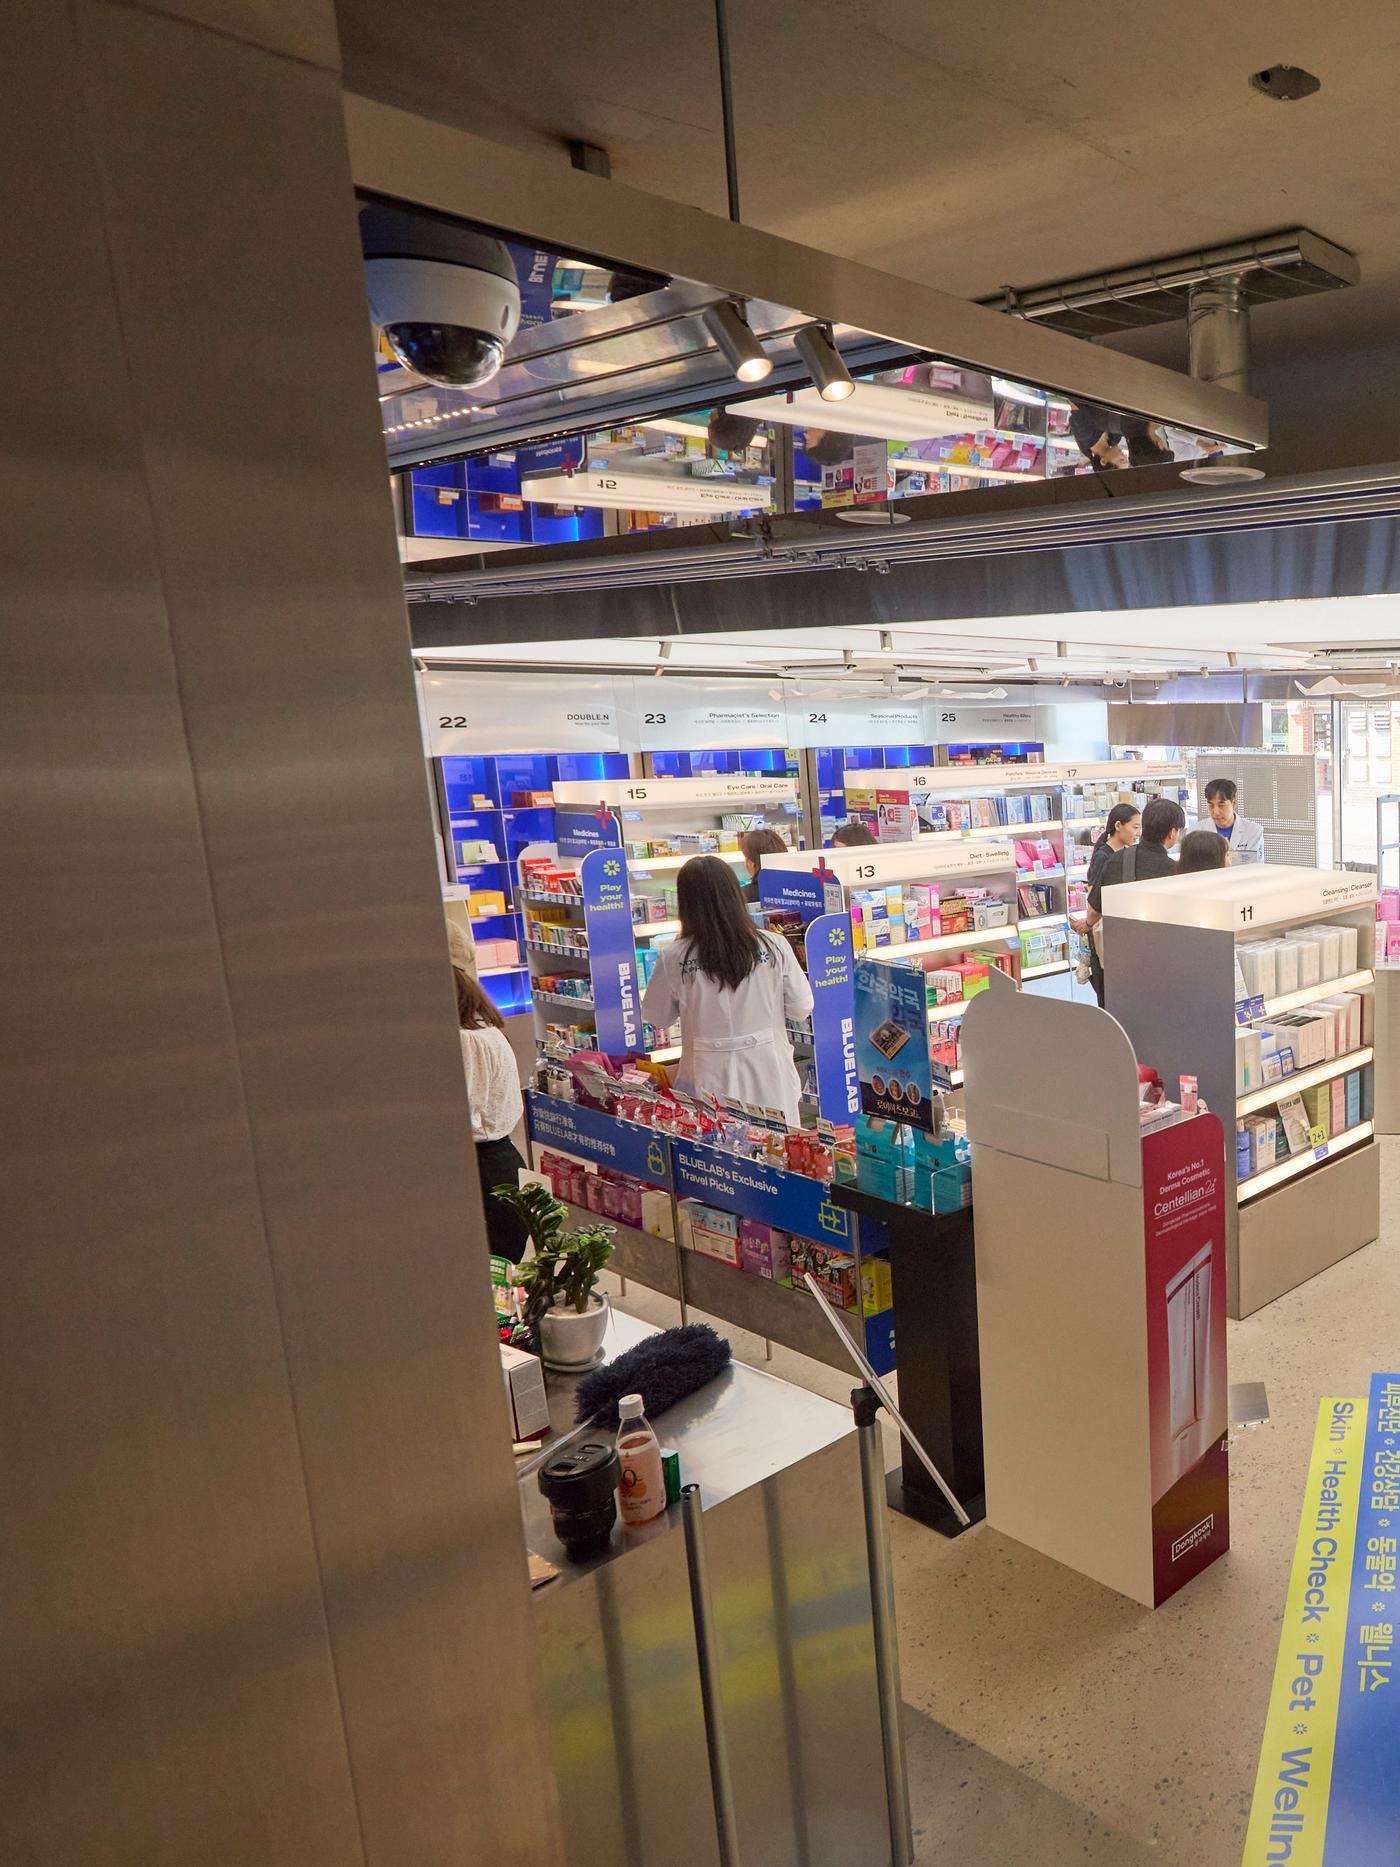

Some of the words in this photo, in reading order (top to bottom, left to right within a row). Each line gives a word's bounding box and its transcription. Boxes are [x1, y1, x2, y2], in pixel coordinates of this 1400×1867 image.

[439, 716, 468, 729] 22
[644, 713, 667, 725] 23
[809, 713, 828, 723] 24
[941, 713, 957, 722] 25
[1066, 769, 1077, 777] 17
[913, 776, 927, 786] 16
[627, 788, 647, 800] 15
[985, 850, 1010, 860] Swelling
[856, 865, 875, 879] 13
[600, 884, 621, 893] Play
[782, 887, 817, 899] Medicines
[1323, 886, 1349, 898] Cleansing
[1351, 882, 1373, 892] Cleanser
[600, 894, 623, 903] your
[589, 902, 624, 912] health!
[1240, 906, 1253, 921] 11
[825, 955, 846, 967] Play
[824, 966, 848, 978] your
[815, 975, 849, 988] health!
[617, 963, 637, 1048] BLUELAB
[841, 1017, 858, 1114] BLUELAB
[1312, 1129, 1326, 1144] 2+1
[678, 1153, 731, 1180] BLUELAB's
[731, 1171, 778, 1196] Exclusive
[1167, 1165, 1191, 1181] Korea's
[1191, 1159, 1205, 1171] No.1
[680, 1168, 708, 1187] Travel
[709, 1178, 735, 1196] Picks
[1159, 1181, 1181, 1195] Derma
[1181, 1168, 1211, 1185] Cosmetic
[1154, 1186, 1204, 1216] Centellian
[1333, 1400, 1355, 1442] Skin
[1316, 1459, 1347, 1531] Health
[1175, 1521, 1211, 1554] Dongkook
[1366, 1535, 1398, 1591] 동물약
[1304, 1537, 1338, 1623] Check
[1357, 1621, 1394, 1693] 웰니스
[1288, 1653, 1324, 1712] Pet
[1265, 1746, 1313, 1867] Welln
